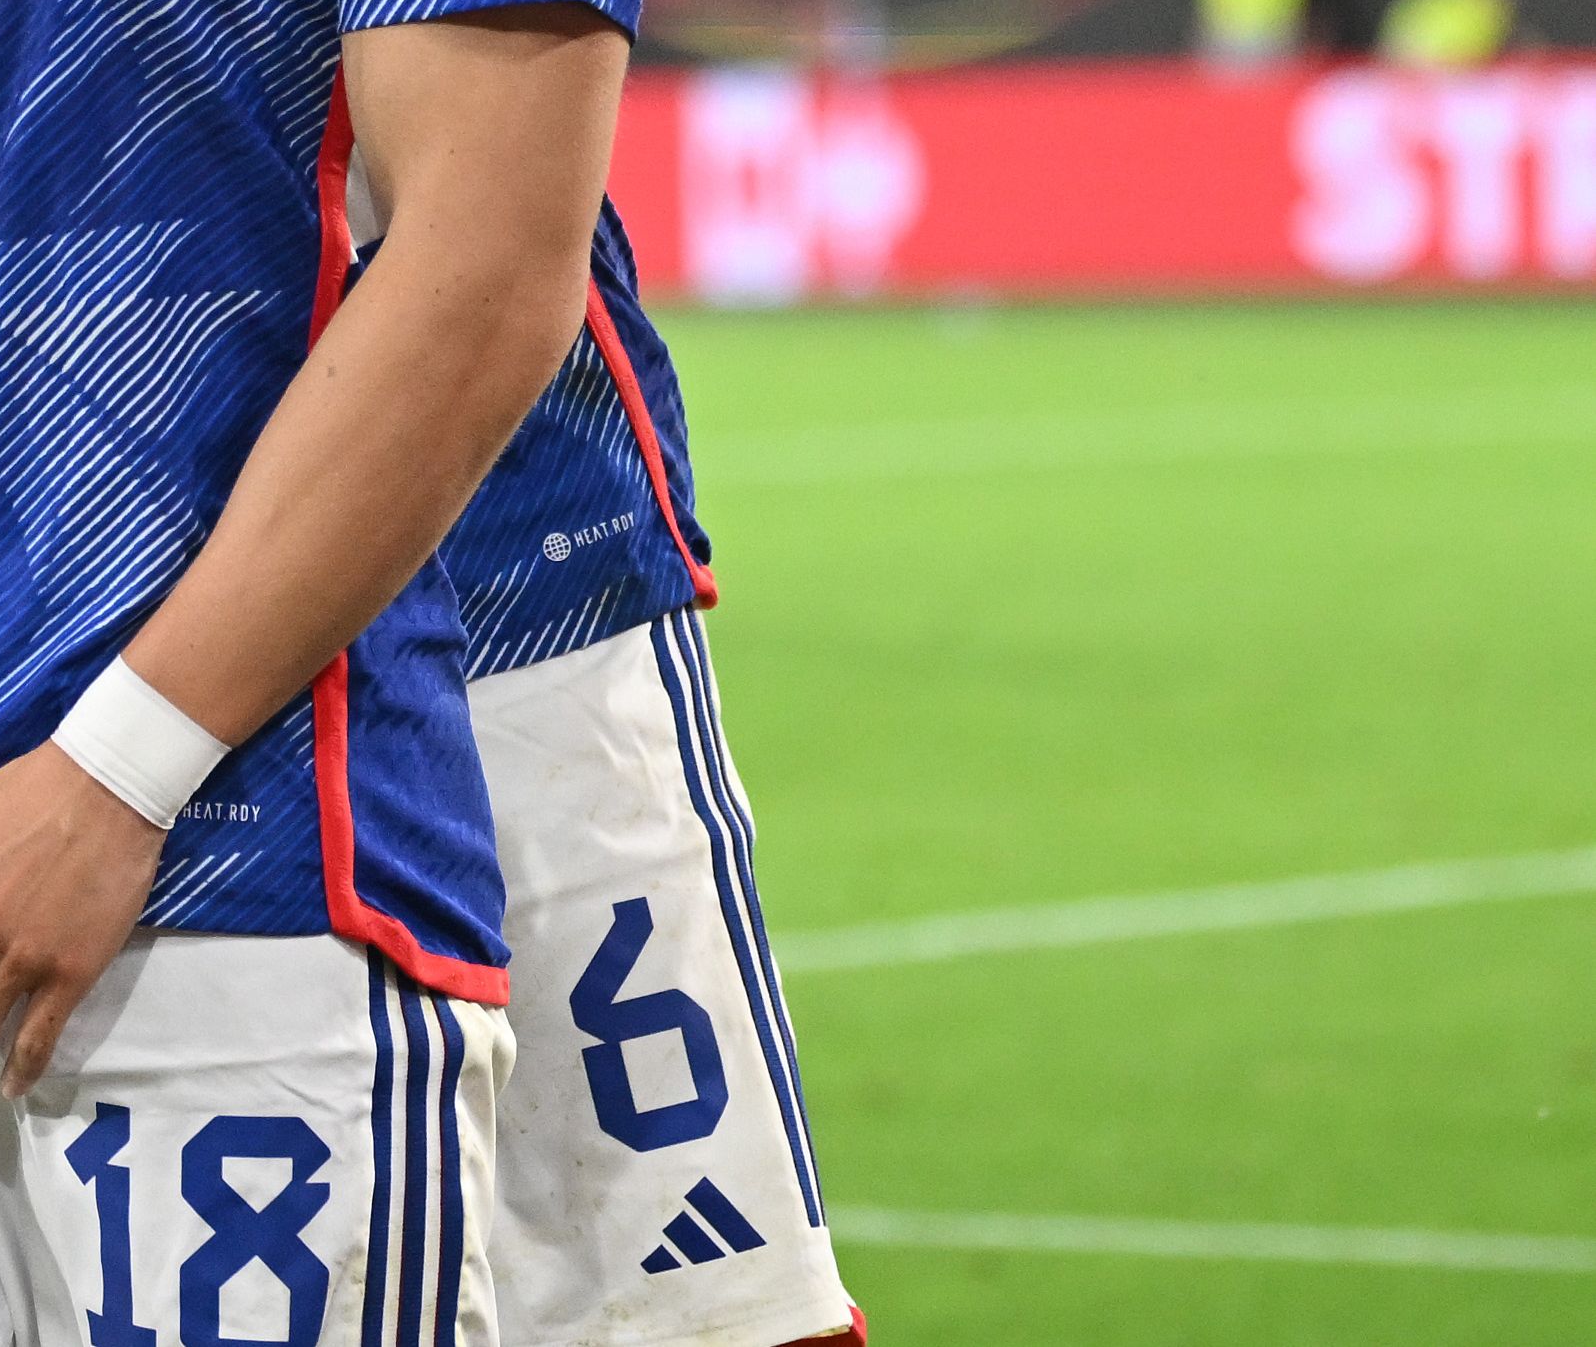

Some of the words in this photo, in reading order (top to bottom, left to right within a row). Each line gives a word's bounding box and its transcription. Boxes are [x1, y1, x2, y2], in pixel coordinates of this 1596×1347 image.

[573, 511, 636, 548] HEAT.RDY
[183, 801, 261, 823] HEAT.RDY
[569, 896, 730, 1153] 6
[64, 1101, 332, 1347] 18
